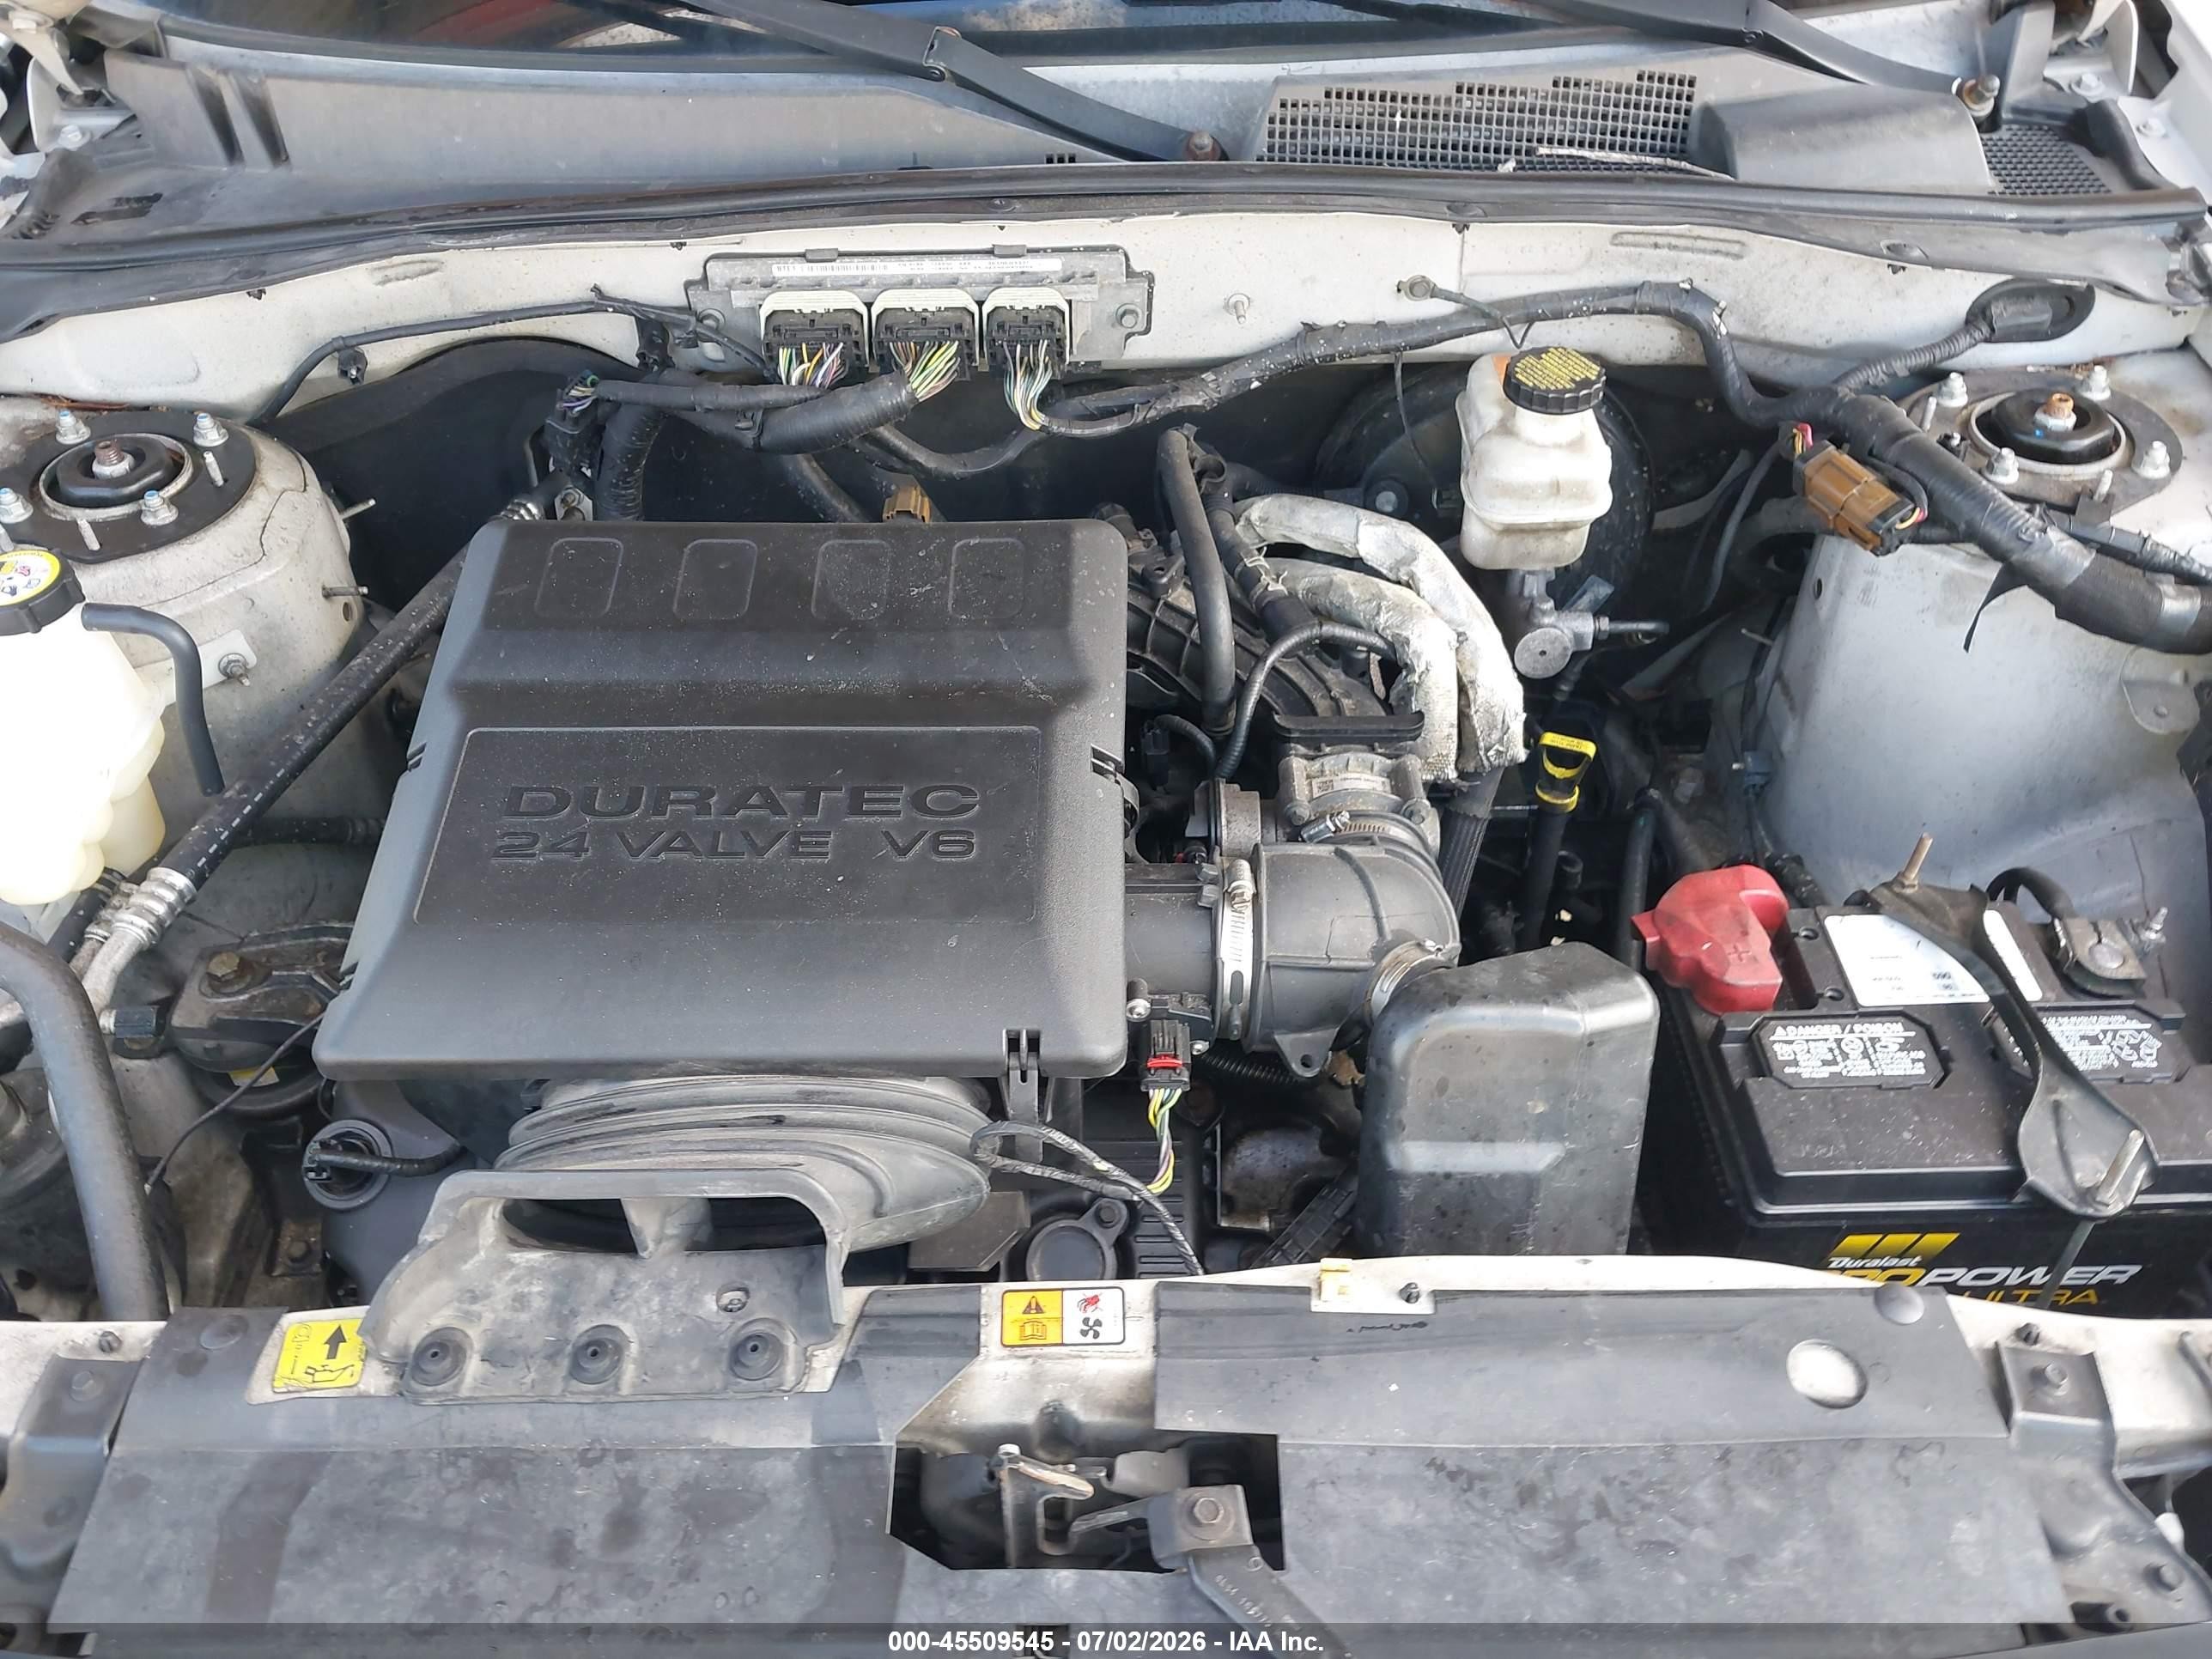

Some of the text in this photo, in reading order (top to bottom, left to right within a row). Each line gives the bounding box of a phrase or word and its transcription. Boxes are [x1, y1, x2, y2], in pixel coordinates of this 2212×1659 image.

[503, 783, 981, 819] DURATEC
[493, 829, 977, 861] 24 VALVE V6
[1826, 1255, 1923, 1269] Duralast
